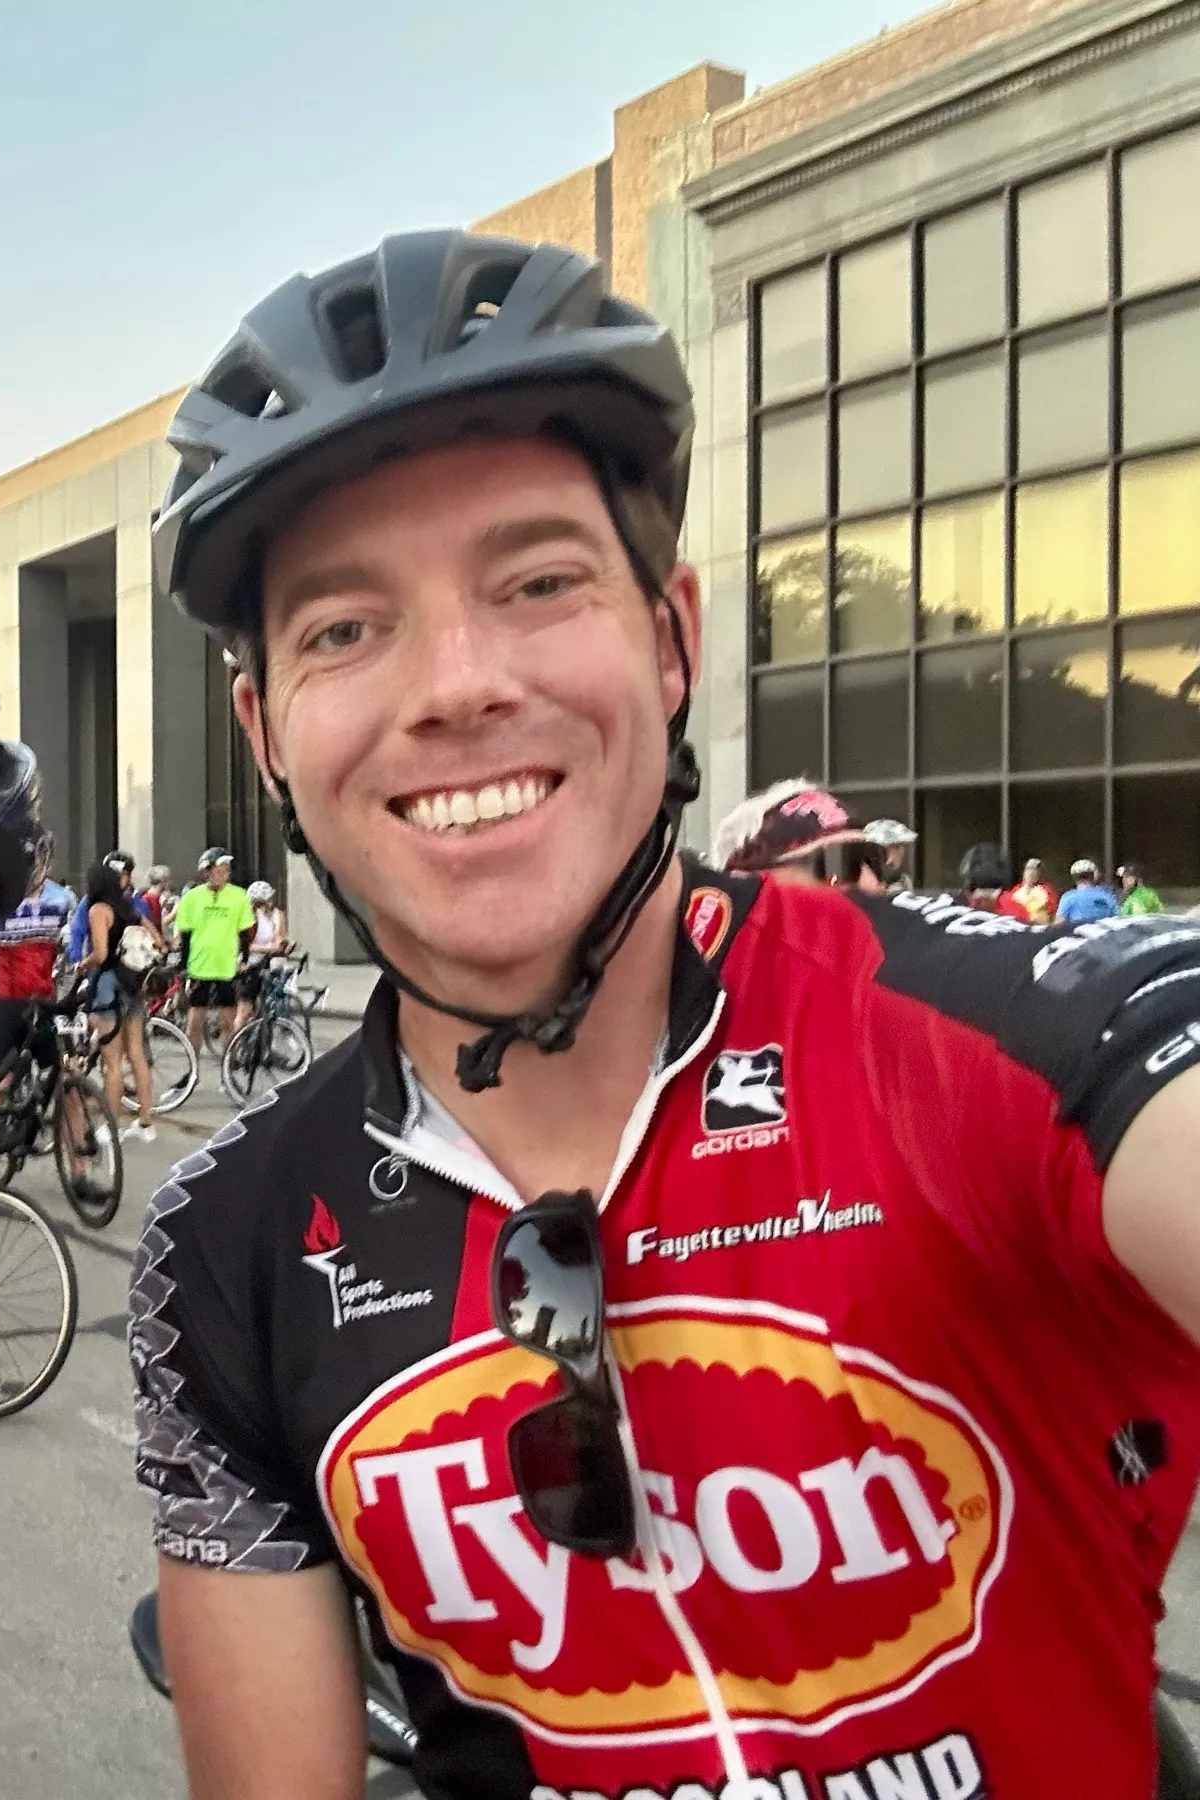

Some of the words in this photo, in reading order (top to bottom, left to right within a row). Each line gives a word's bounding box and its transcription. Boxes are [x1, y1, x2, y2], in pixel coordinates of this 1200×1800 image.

[626, 1217, 800, 1266] Fayetteville
[338, 1262, 357, 1285] All
[340, 1279, 384, 1304] Sports
[342, 1289, 434, 1323] Productions
[354, 1437, 959, 1672] Tyson
